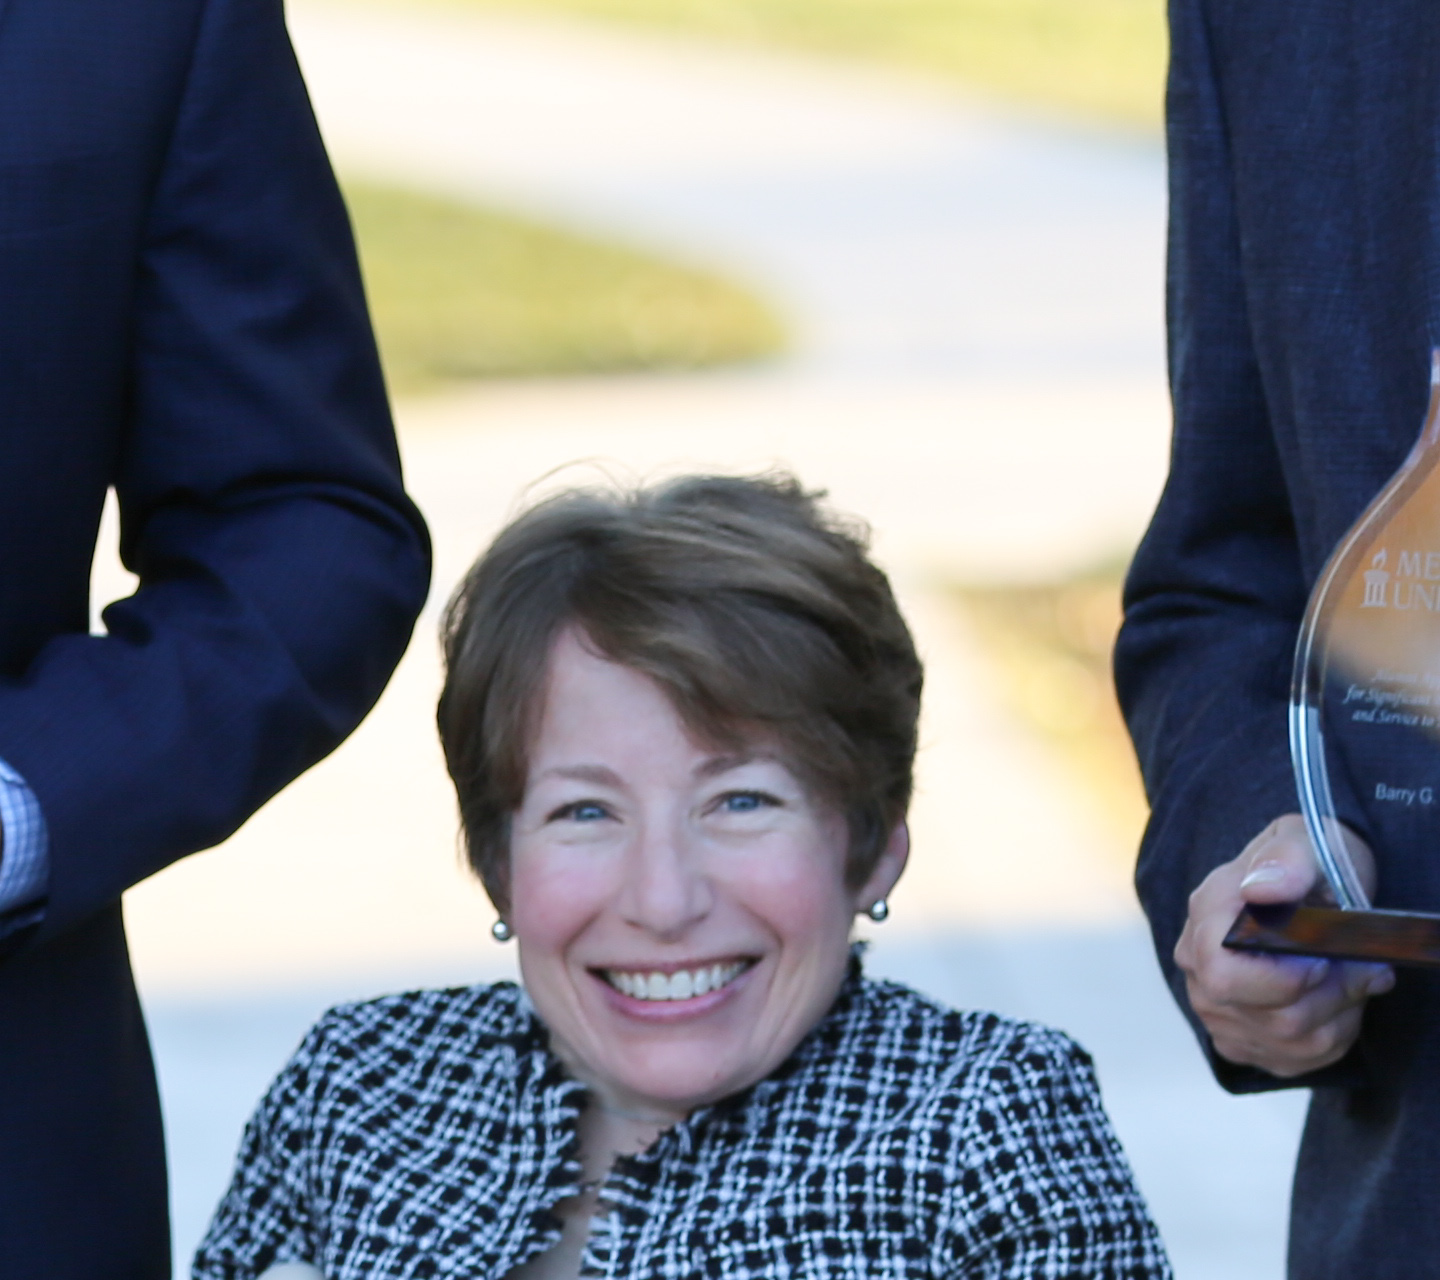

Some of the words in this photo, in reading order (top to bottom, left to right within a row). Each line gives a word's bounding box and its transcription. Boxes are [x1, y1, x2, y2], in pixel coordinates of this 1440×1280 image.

[1342, 684, 1366, 705] for
[1352, 709, 1377, 724] and
[1377, 710, 1419, 727] Service
[1421, 714, 1435, 728] to
[1375, 782, 1416, 806] Barry
